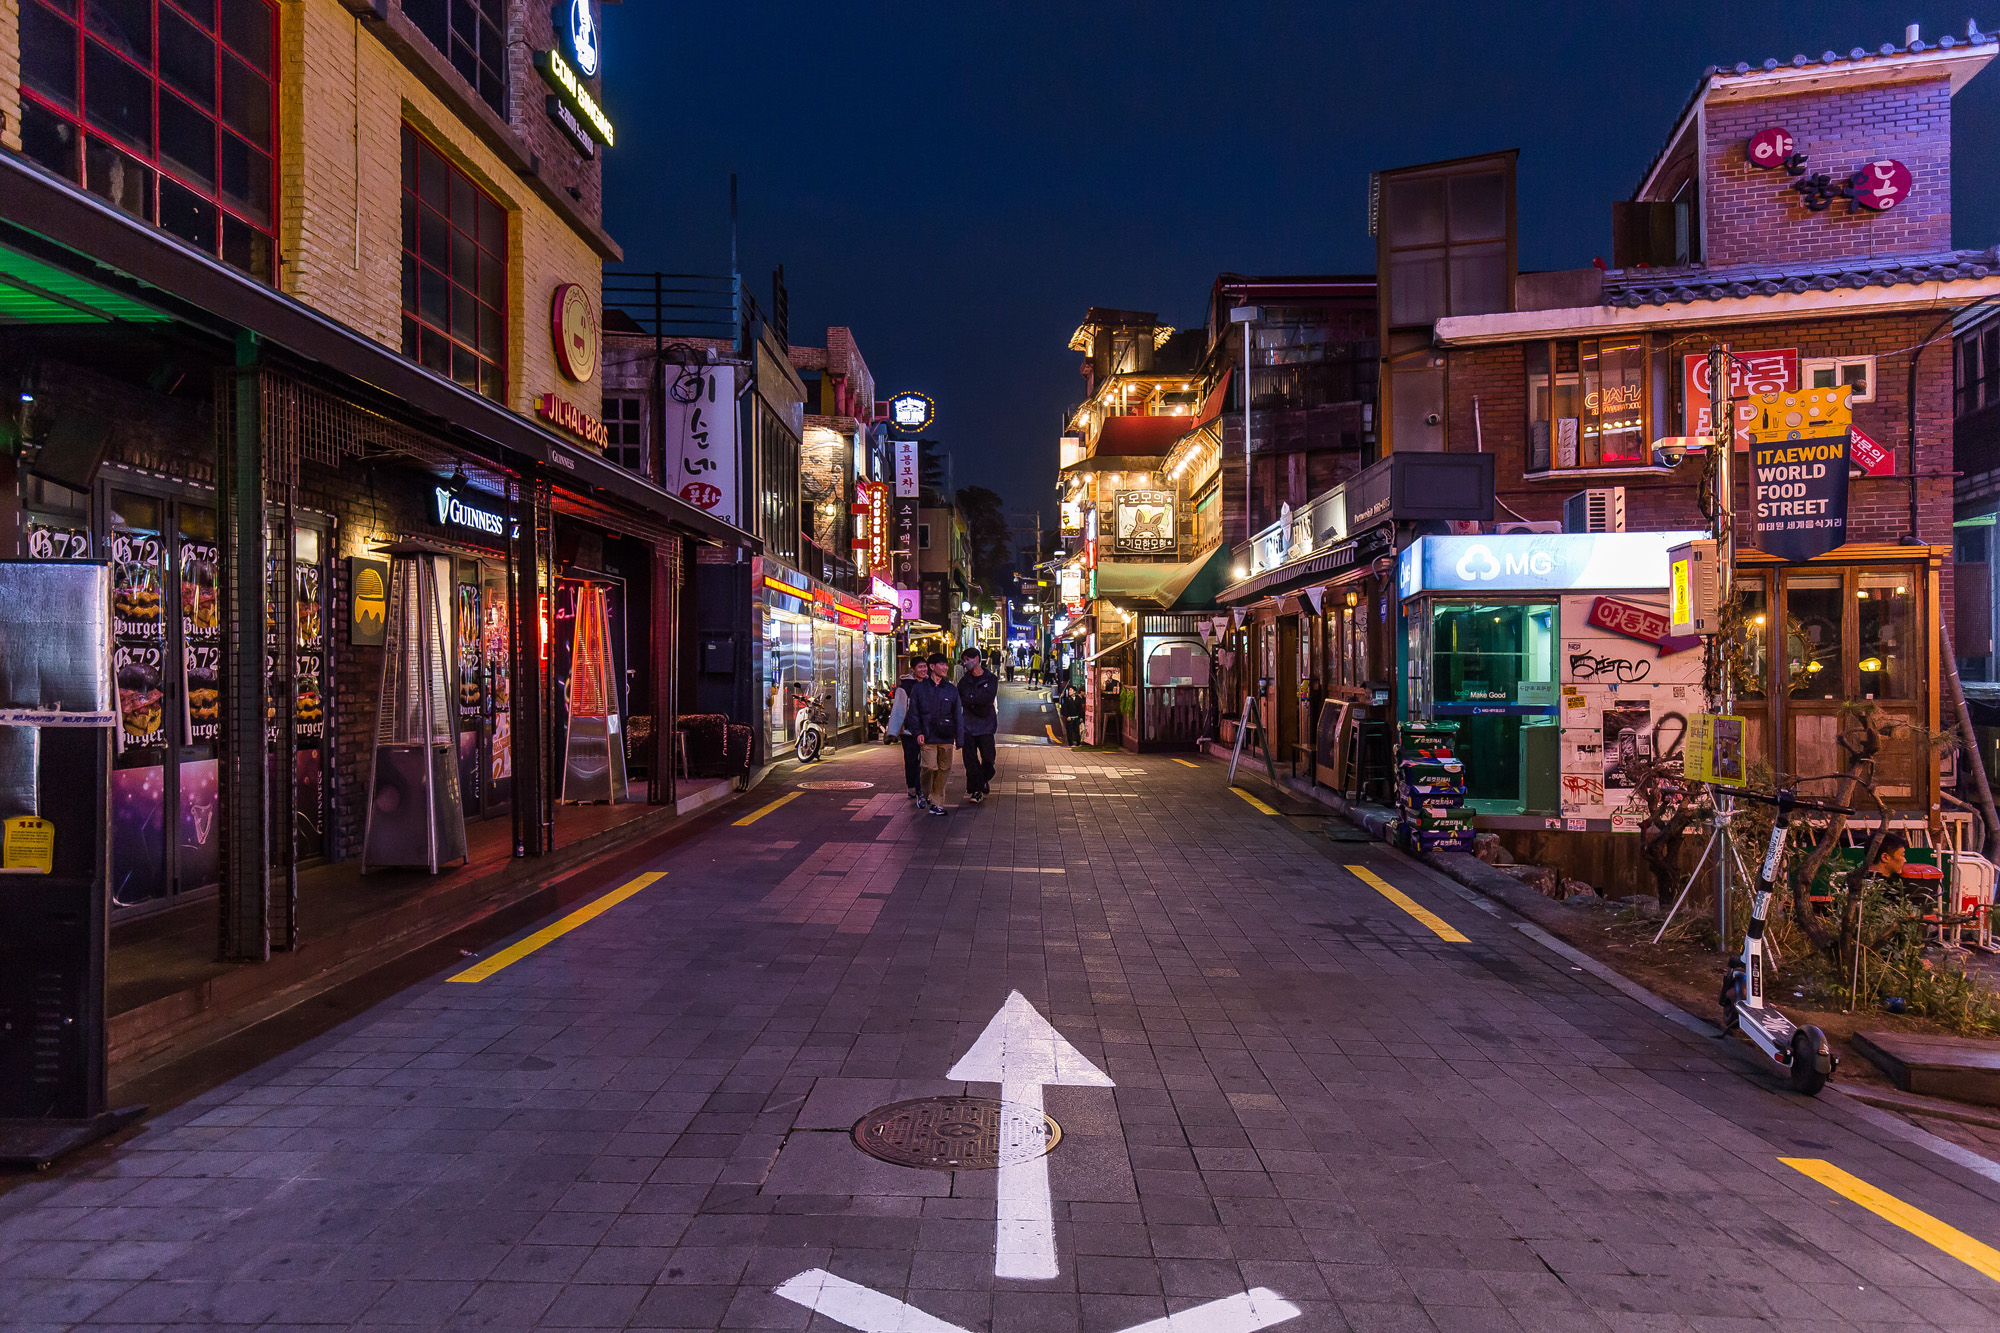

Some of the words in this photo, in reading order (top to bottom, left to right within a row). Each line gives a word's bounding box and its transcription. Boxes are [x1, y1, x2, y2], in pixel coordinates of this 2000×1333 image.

[552, 49, 577, 98] COIN
[577, 83, 614, 147] SINGING
[549, 394, 583, 436] JILHAL
[585, 414, 609, 449] BROS
[684, 373, 717, 475] 기순네
[552, 450, 575, 470] GUINNESS
[1756, 443, 1843, 465] ITAEWON
[1757, 463, 1826, 482] WORLD
[1128, 492, 1164, 504] 모모의
[1757, 483, 1807, 500] FOOD
[449, 498, 503, 535] GUINNESS
[872, 490, 882, 534] HOUSE
[1757, 498, 1829, 518] STREET
[1757, 521, 1784, 532] 이태원
[1786, 517, 1843, 530] 세계음식거리
[1505, 552, 1552, 575] MG
[1470, 691, 1488, 699] Make
[1488, 691, 1506, 699] Good
